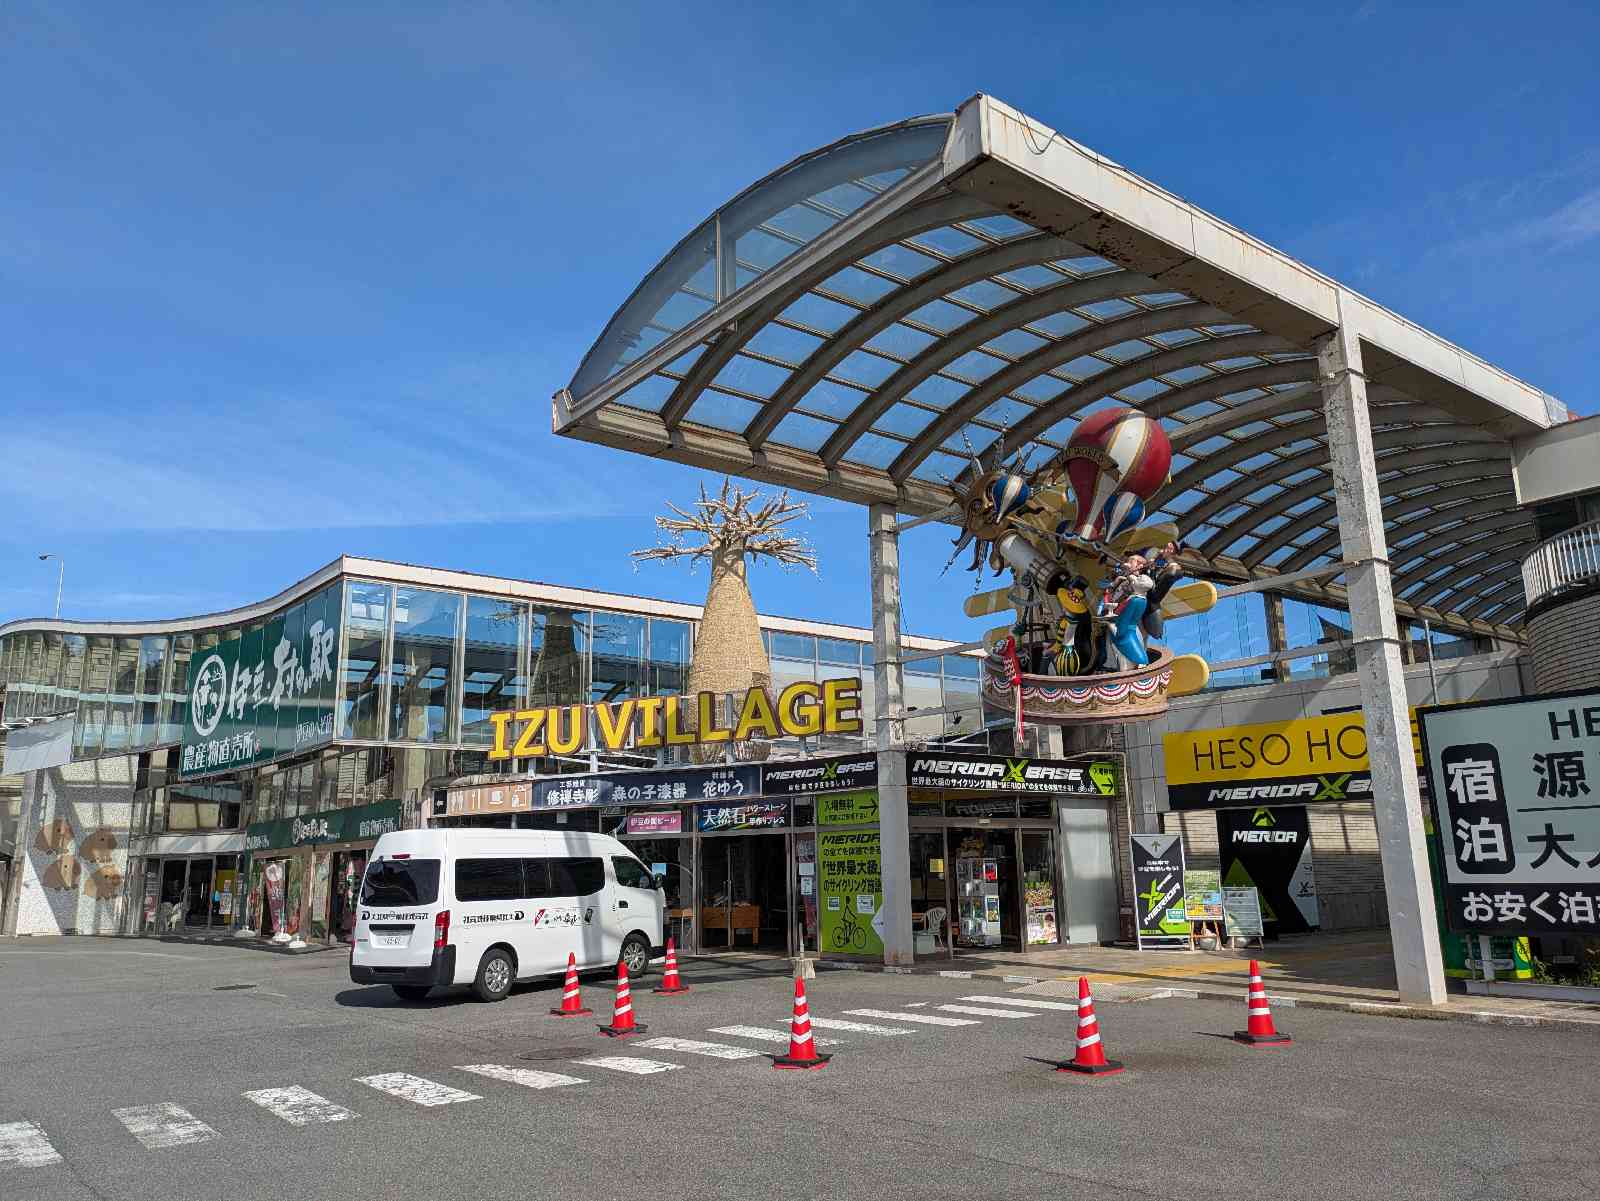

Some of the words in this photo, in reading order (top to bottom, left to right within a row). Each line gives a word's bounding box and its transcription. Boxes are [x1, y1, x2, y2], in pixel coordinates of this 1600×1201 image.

[488, 704, 586, 761] IZU
[593, 677, 863, 750] VILLAGE
[183, 731, 254, 771] 農産物直売所
[1193, 733, 1290, 771] HESO
[1306, 725, 1367, 762] HO
[765, 767, 825, 781] MERIDA
[836, 761, 876, 774] BASE
[912, 760, 1006, 777] MERIDA
[1026, 766, 1083, 781] BASE
[703, 780, 744, 797] 花ゆう
[1208, 782, 1318, 801] MERIDA
[703, 807, 746, 826] 天然石
[1447, 758, 1507, 862] 宿泊
[1232, 830, 1298, 843] MERIDA
[1462, 891, 1600, 924] お安く泊
